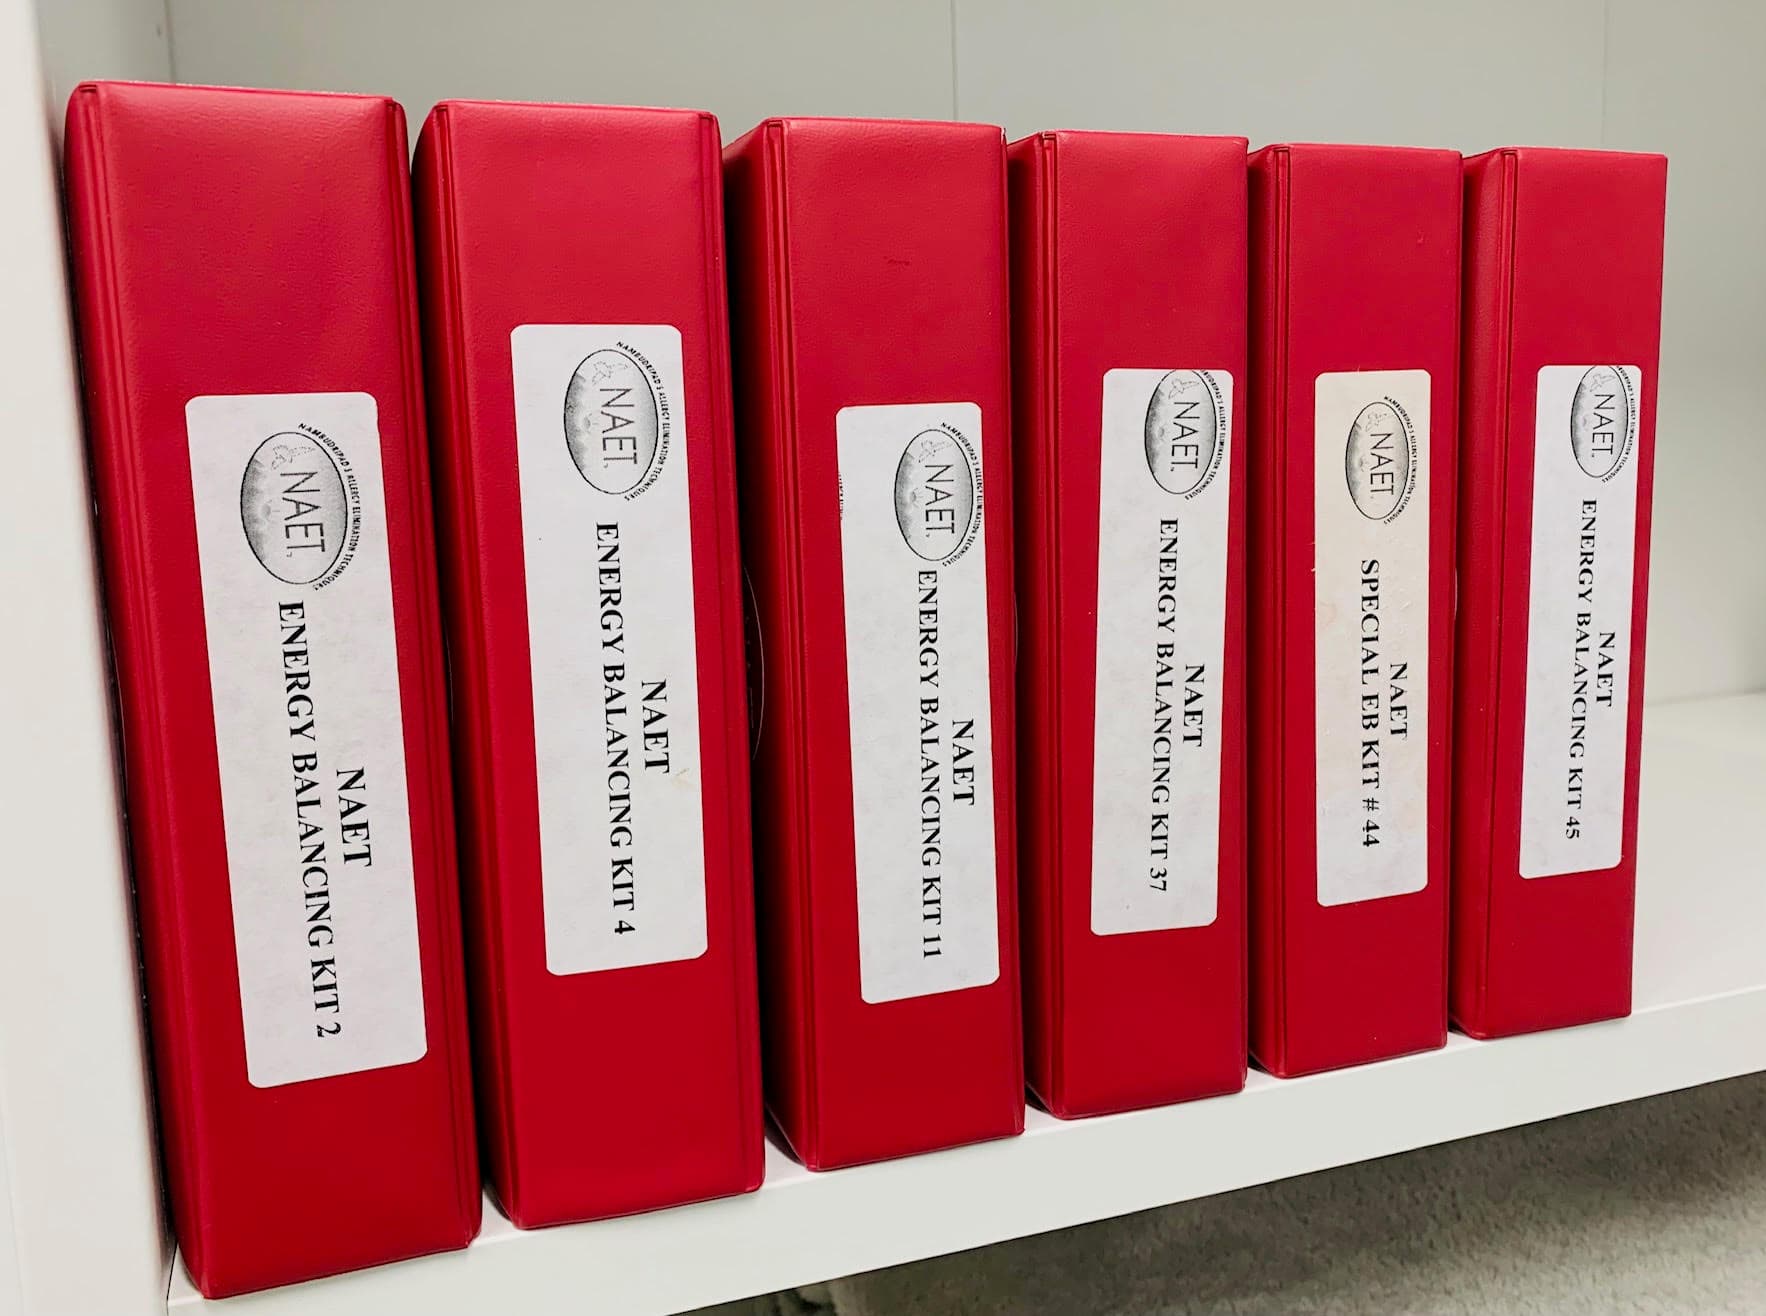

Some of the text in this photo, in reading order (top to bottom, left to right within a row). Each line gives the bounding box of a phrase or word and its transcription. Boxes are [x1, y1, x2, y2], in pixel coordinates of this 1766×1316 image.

[599, 388, 638, 464] NAET
[1171, 401, 1200, 469] NAET
[1369, 432, 1394, 495] NAET
[1591, 394, 1615, 455] NAET
[280, 471, 326, 552] NAET
[925, 464, 955, 534] NAET
[1149, 518, 1179, 892] ENERGY BALANCING KIT 37
[1182, 663, 1205, 748] NAET
[1361, 559, 1380, 848] SPECIAL EB KIT # 44
[1389, 661, 1408, 738] NAET
[1565, 499, 1597, 840] ENERGY BALANCING KIT 45
[1595, 631, 1616, 708] NAET
[596, 522, 636, 935] ENERGY BALANCING KIT 4
[641, 678, 670, 774] NAET
[918, 570, 942, 959] ENERGY BALANCING KIT 11
[952, 718, 975, 806] NAET
[278, 600, 342, 1038] ENERGY BALANCING KIT 2
[336, 767, 373, 867] NAET
